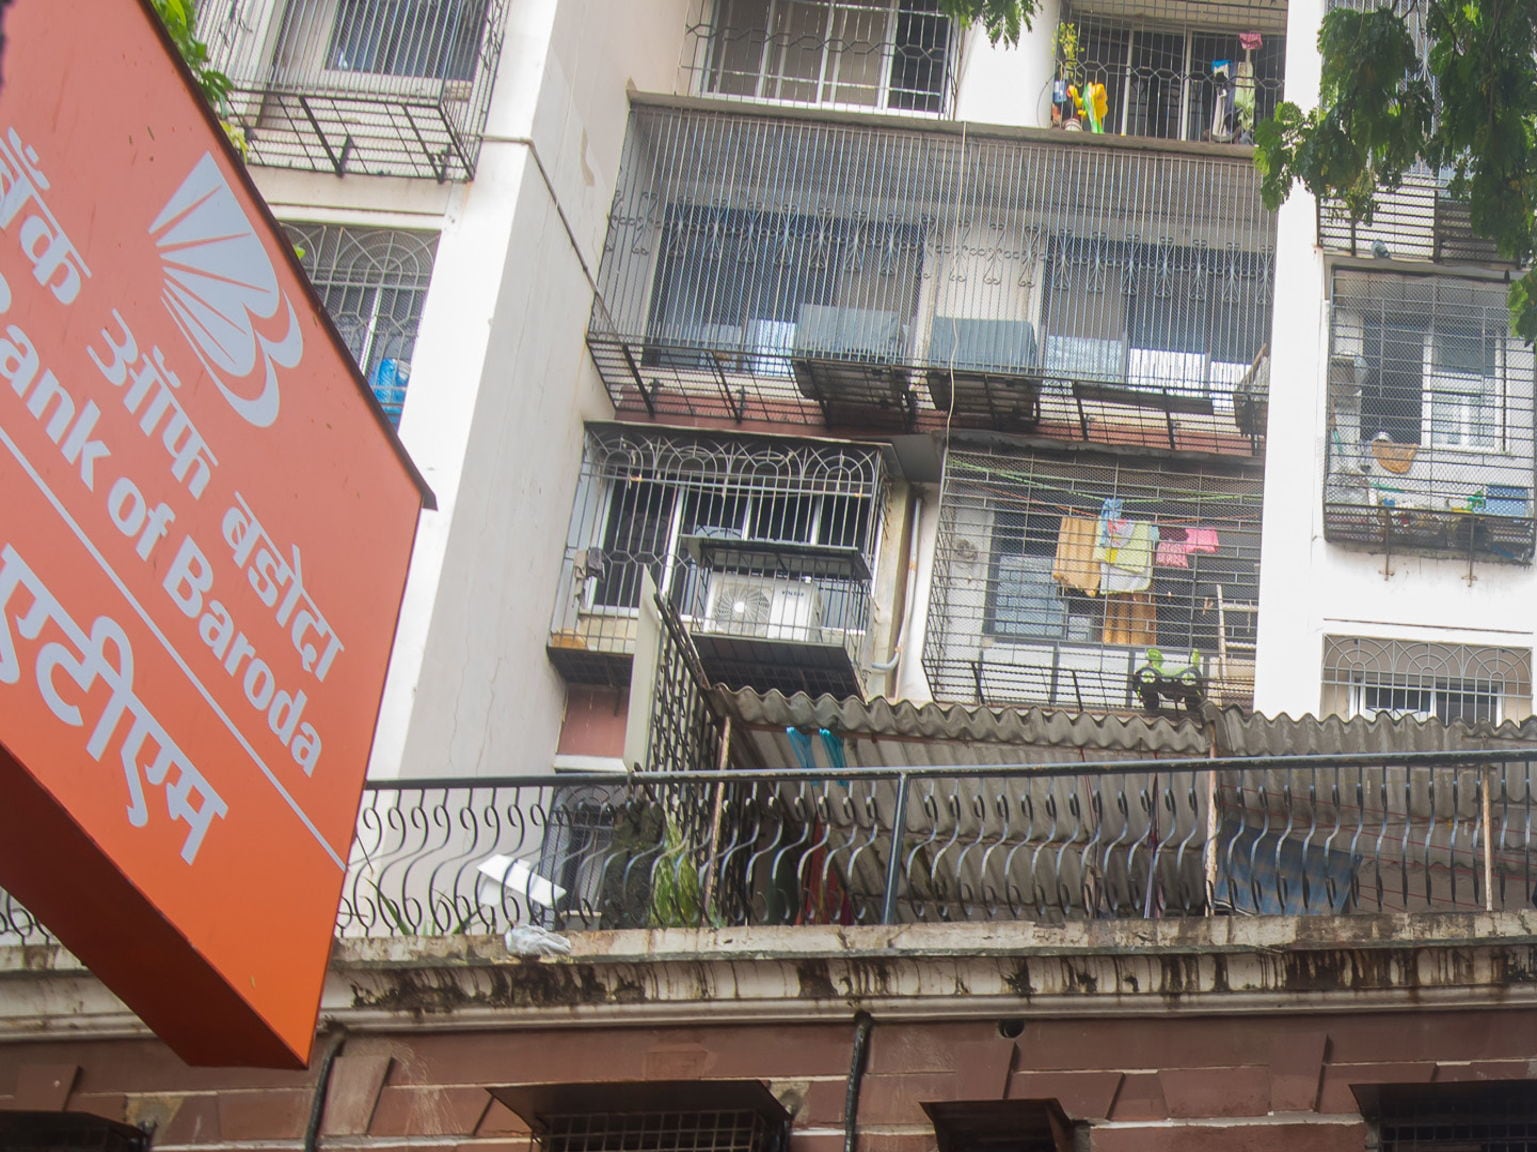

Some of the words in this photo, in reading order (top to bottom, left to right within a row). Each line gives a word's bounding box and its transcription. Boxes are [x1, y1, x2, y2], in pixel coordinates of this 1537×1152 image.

[0, 270, 112, 493] ank
[107, 476, 176, 562] of
[162, 534, 322, 777] Baroda
[86, 308, 219, 500] ऑफ
[221, 491, 345, 682] बडोदा
